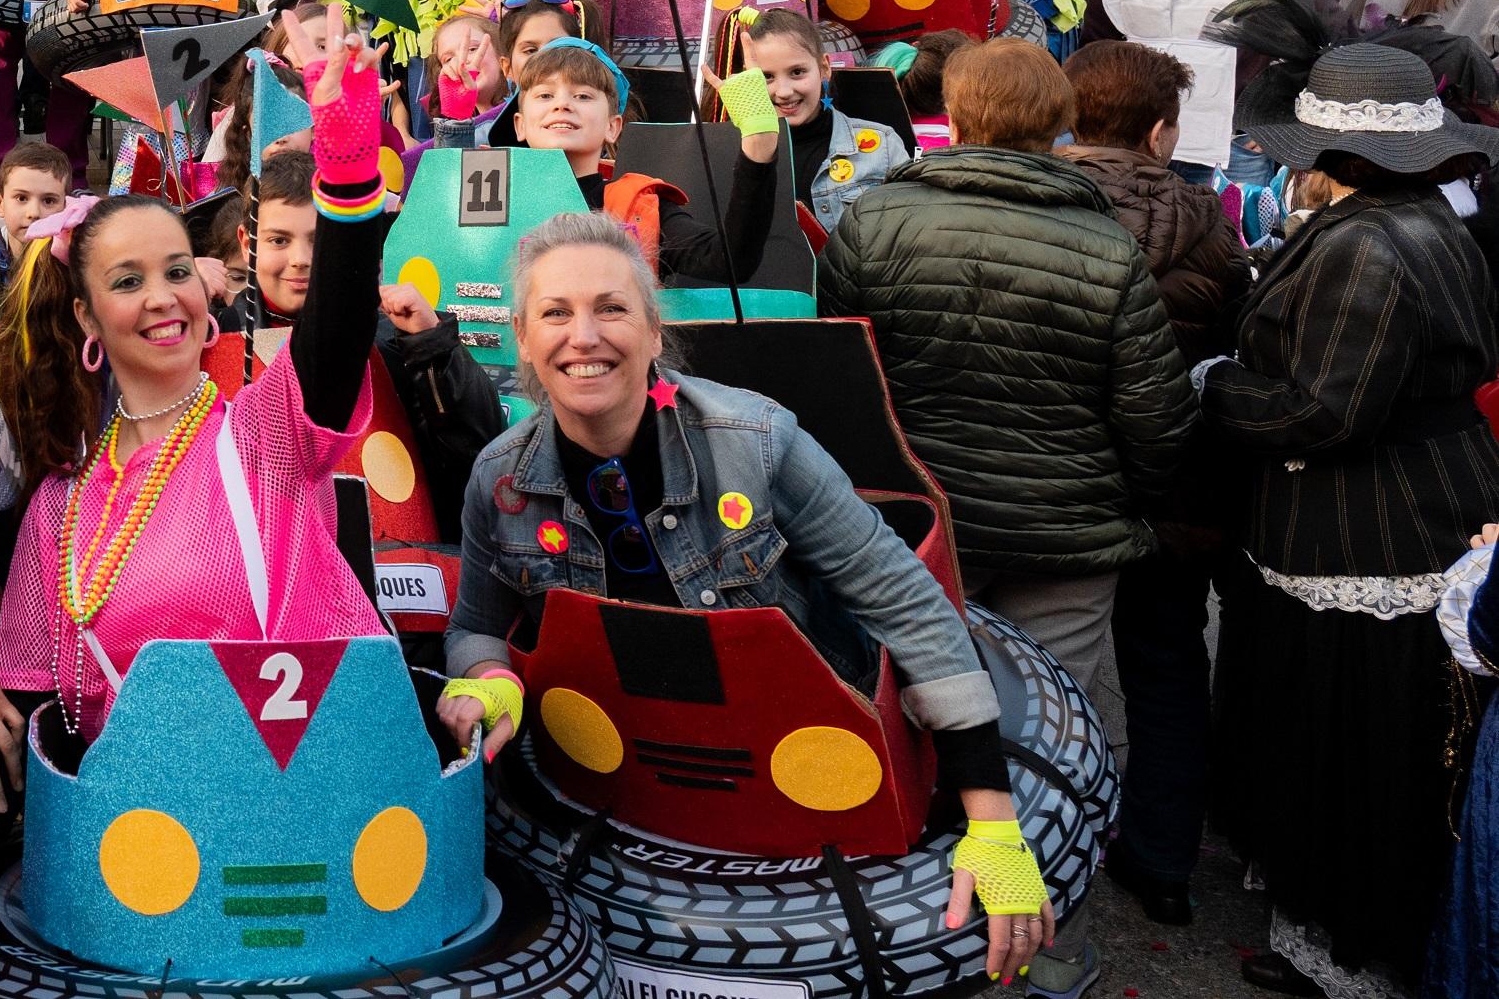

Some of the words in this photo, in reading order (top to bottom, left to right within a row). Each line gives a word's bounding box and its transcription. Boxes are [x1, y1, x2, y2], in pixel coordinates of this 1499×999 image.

[172, 37, 210, 81] 2
[467, 169, 502, 212] 11
[259, 652, 308, 722] 2
